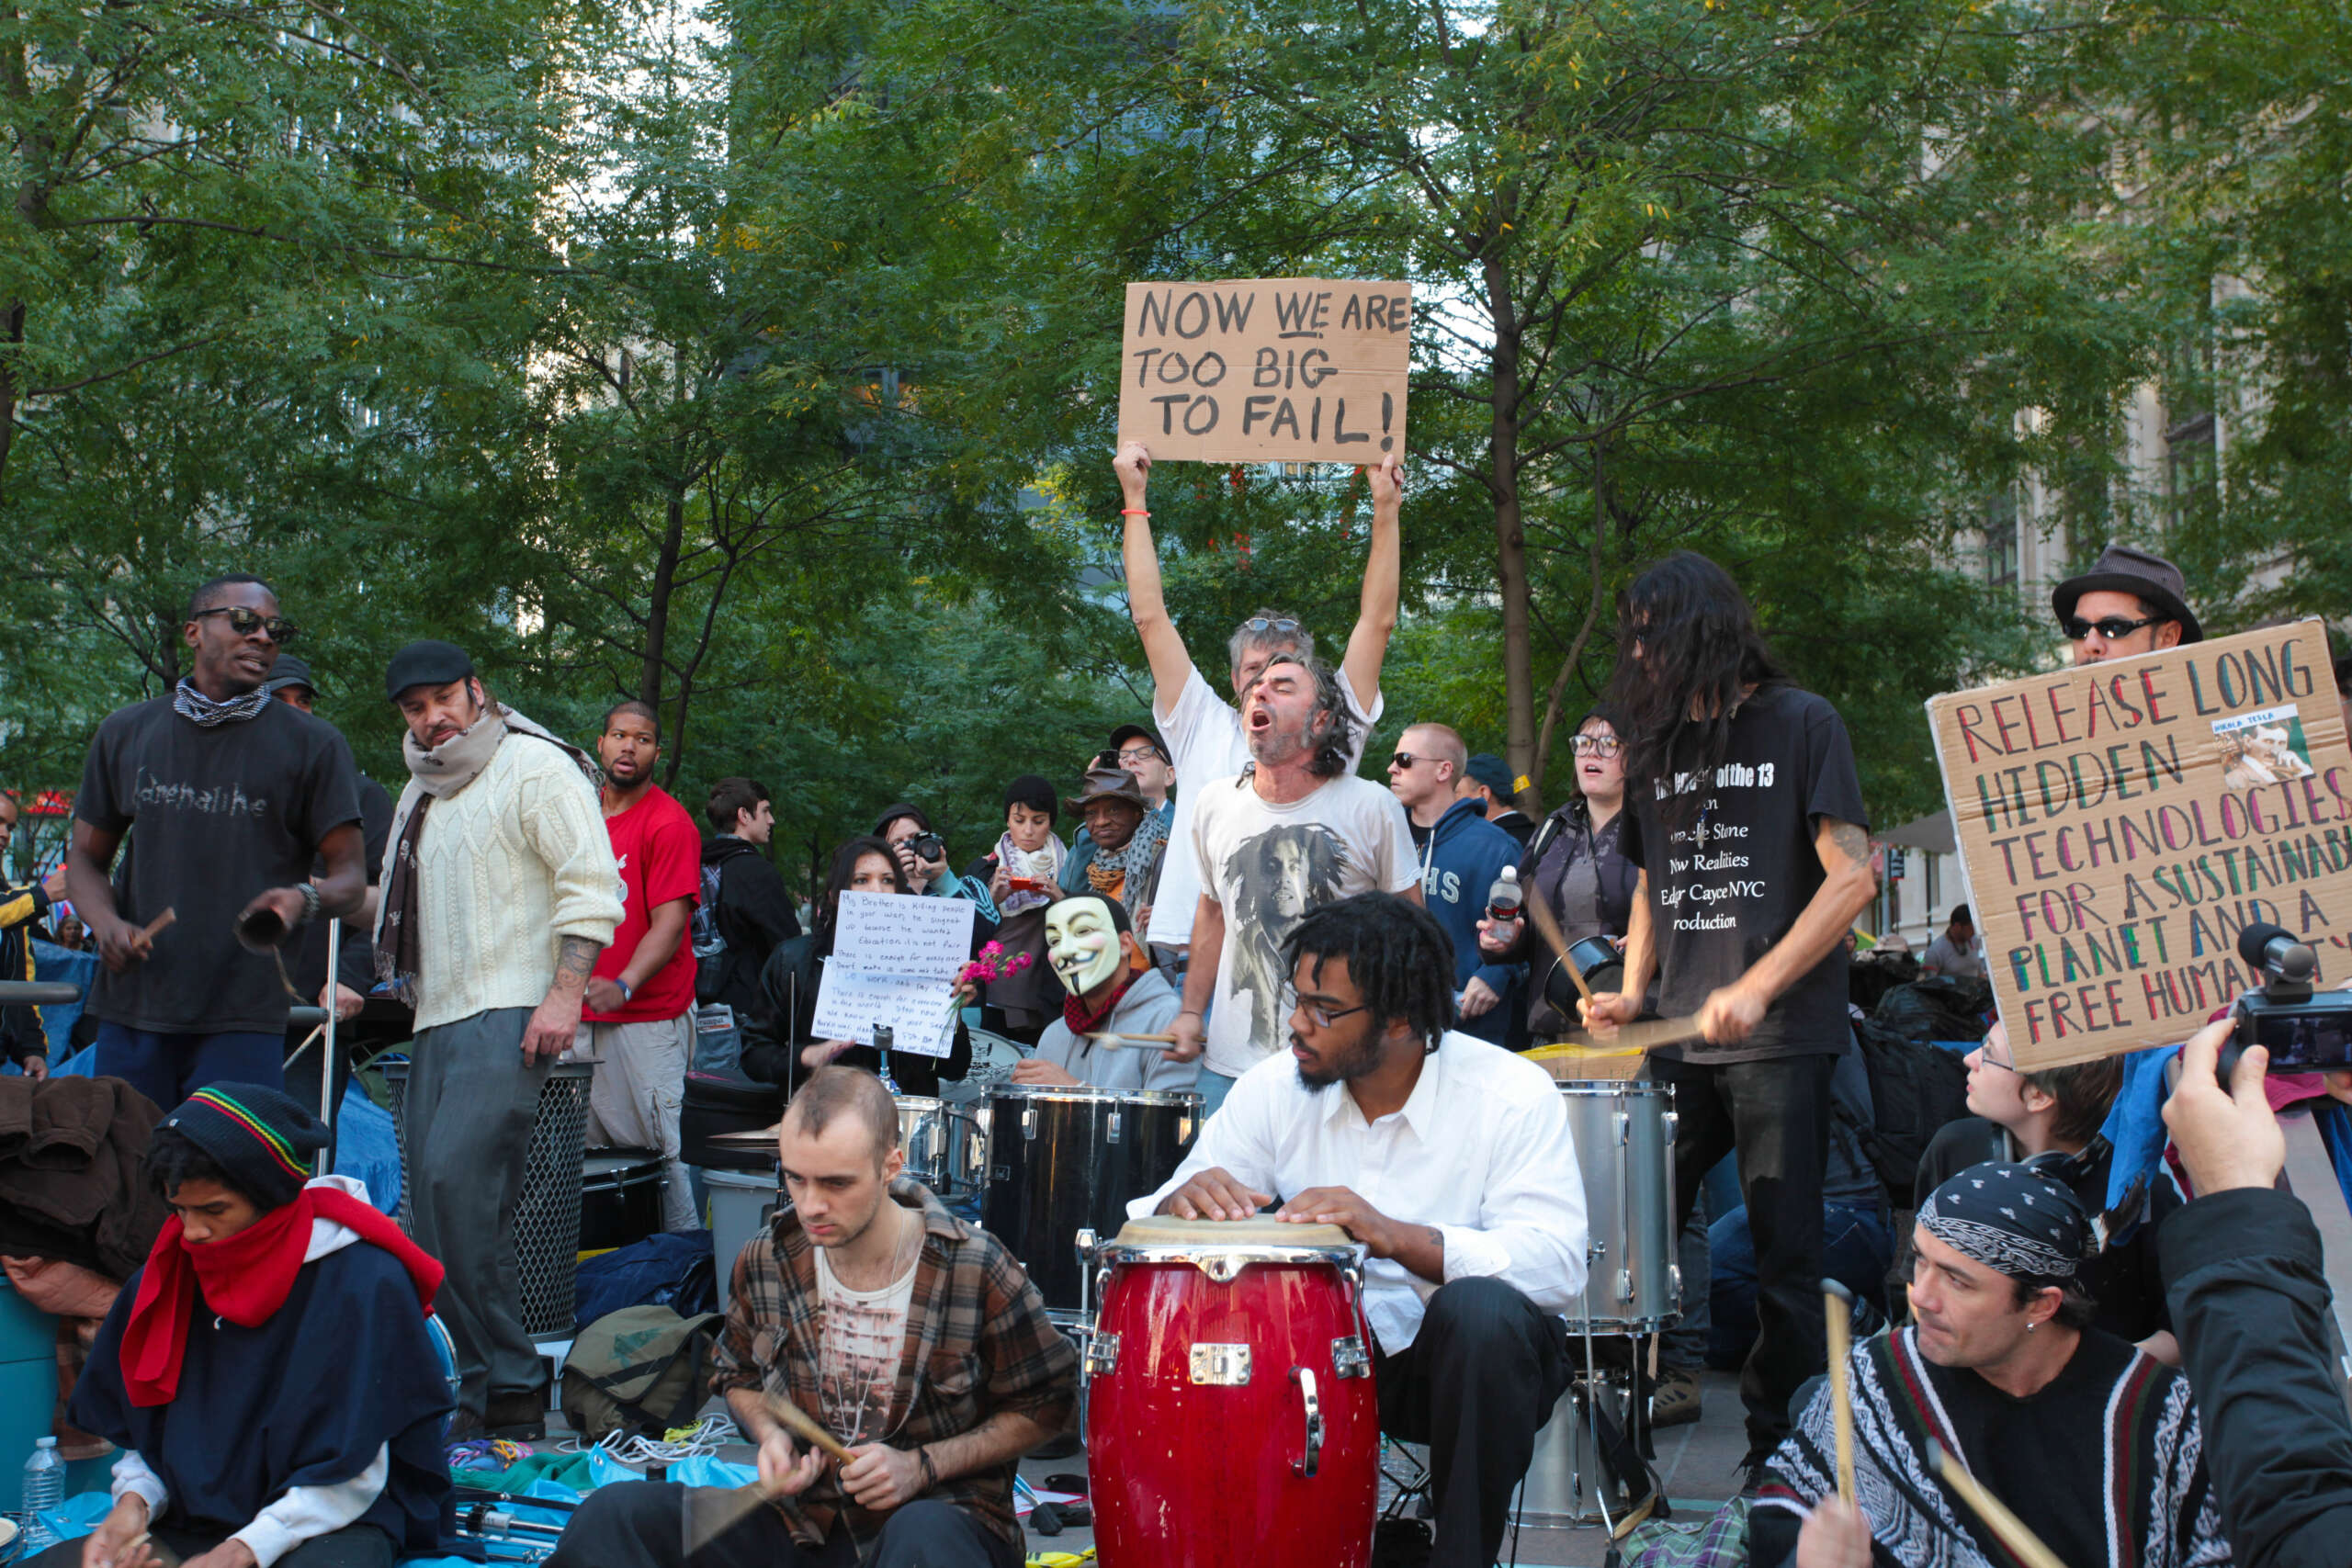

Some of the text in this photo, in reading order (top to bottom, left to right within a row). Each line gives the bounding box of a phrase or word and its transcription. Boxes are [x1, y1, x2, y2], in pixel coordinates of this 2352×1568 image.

[1138, 289, 1409, 339] NOW WE ARE
[1133, 346, 1338, 389] TOO BIG
[1150, 391, 1393, 452] TO FAIL!
[1956, 639, 2314, 763] RELEASE LONG
[1757, 762, 1774, 787] 13
[1976, 734, 2183, 833] HIDDEN
[1713, 823, 1749, 840] Stone
[1990, 765, 2352, 886] TECHNOLOGIES
[1693, 851, 1749, 872] Realities
[1689, 884, 1728, 907] Cayce
[1728, 881, 1765, 898] NYC
[2016, 882, 2109, 942] FOR
[2007, 887, 2330, 992] PLANET AND A
[2023, 931, 2352, 1044] FREE HUMAT
